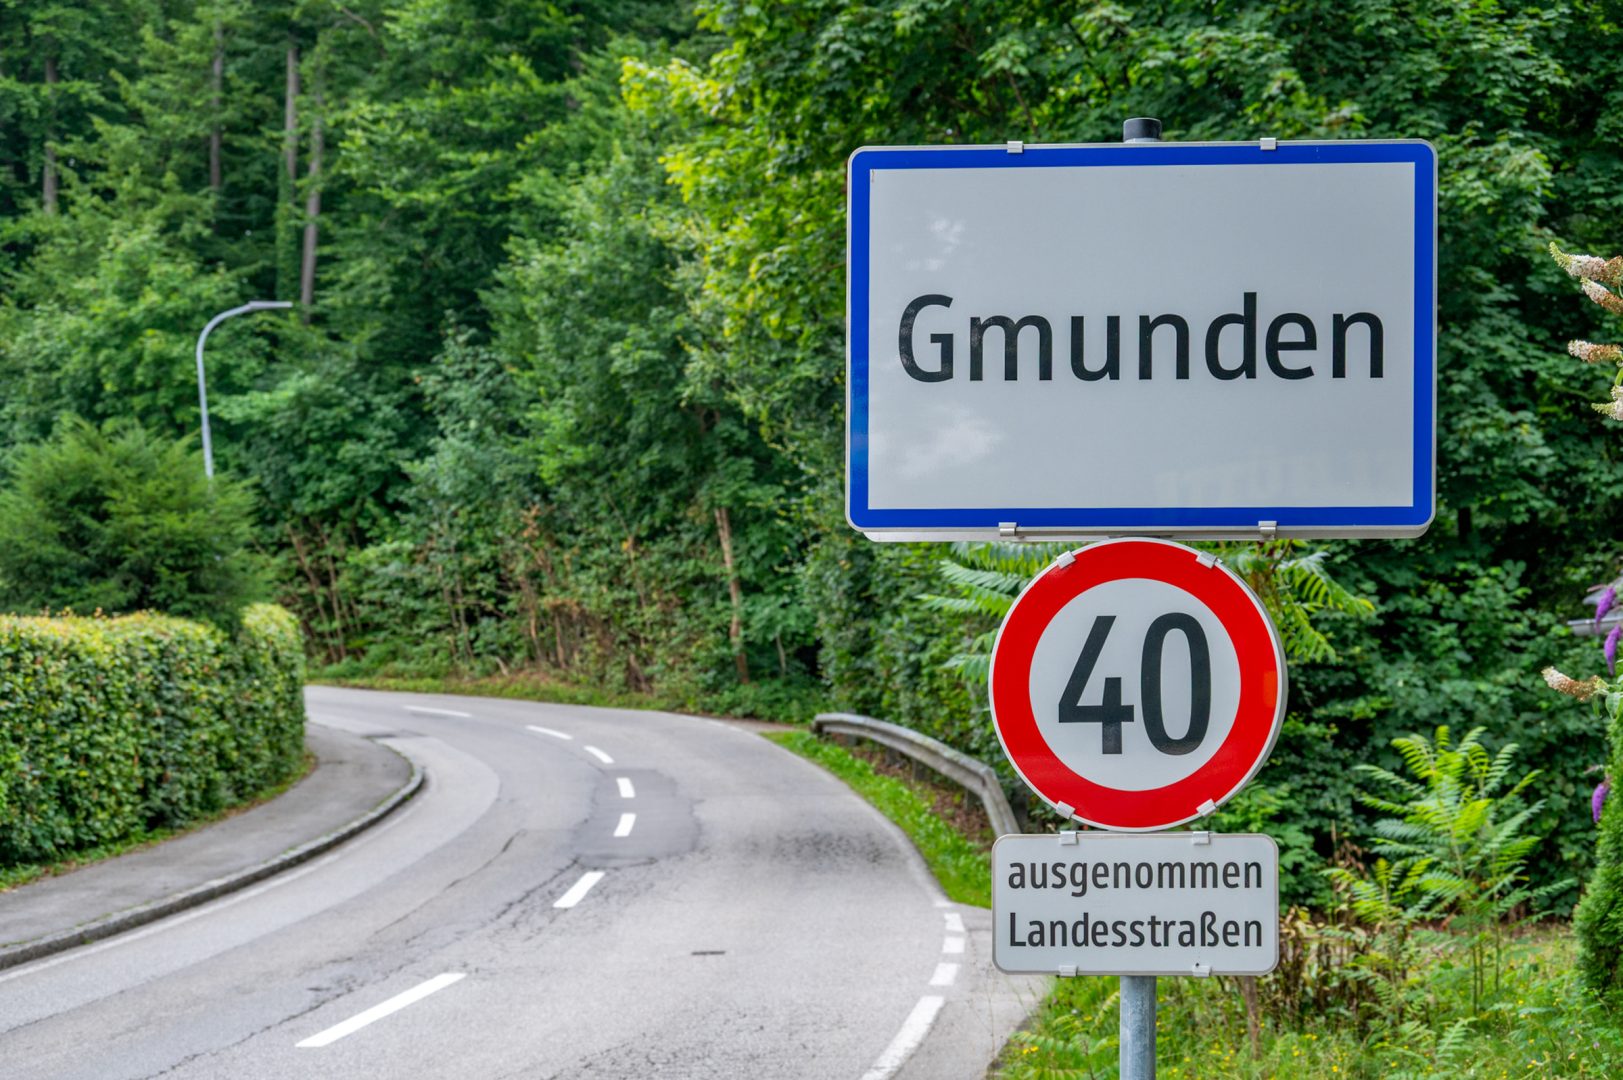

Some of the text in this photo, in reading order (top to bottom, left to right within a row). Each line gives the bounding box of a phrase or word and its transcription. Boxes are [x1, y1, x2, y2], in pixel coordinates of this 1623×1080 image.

[898, 291, 1384, 383] Gmunden
[1058, 612, 1212, 756] 40
[1008, 861, 1263, 898] ausgenommen
[1009, 911, 1263, 948] Landesstraßen
